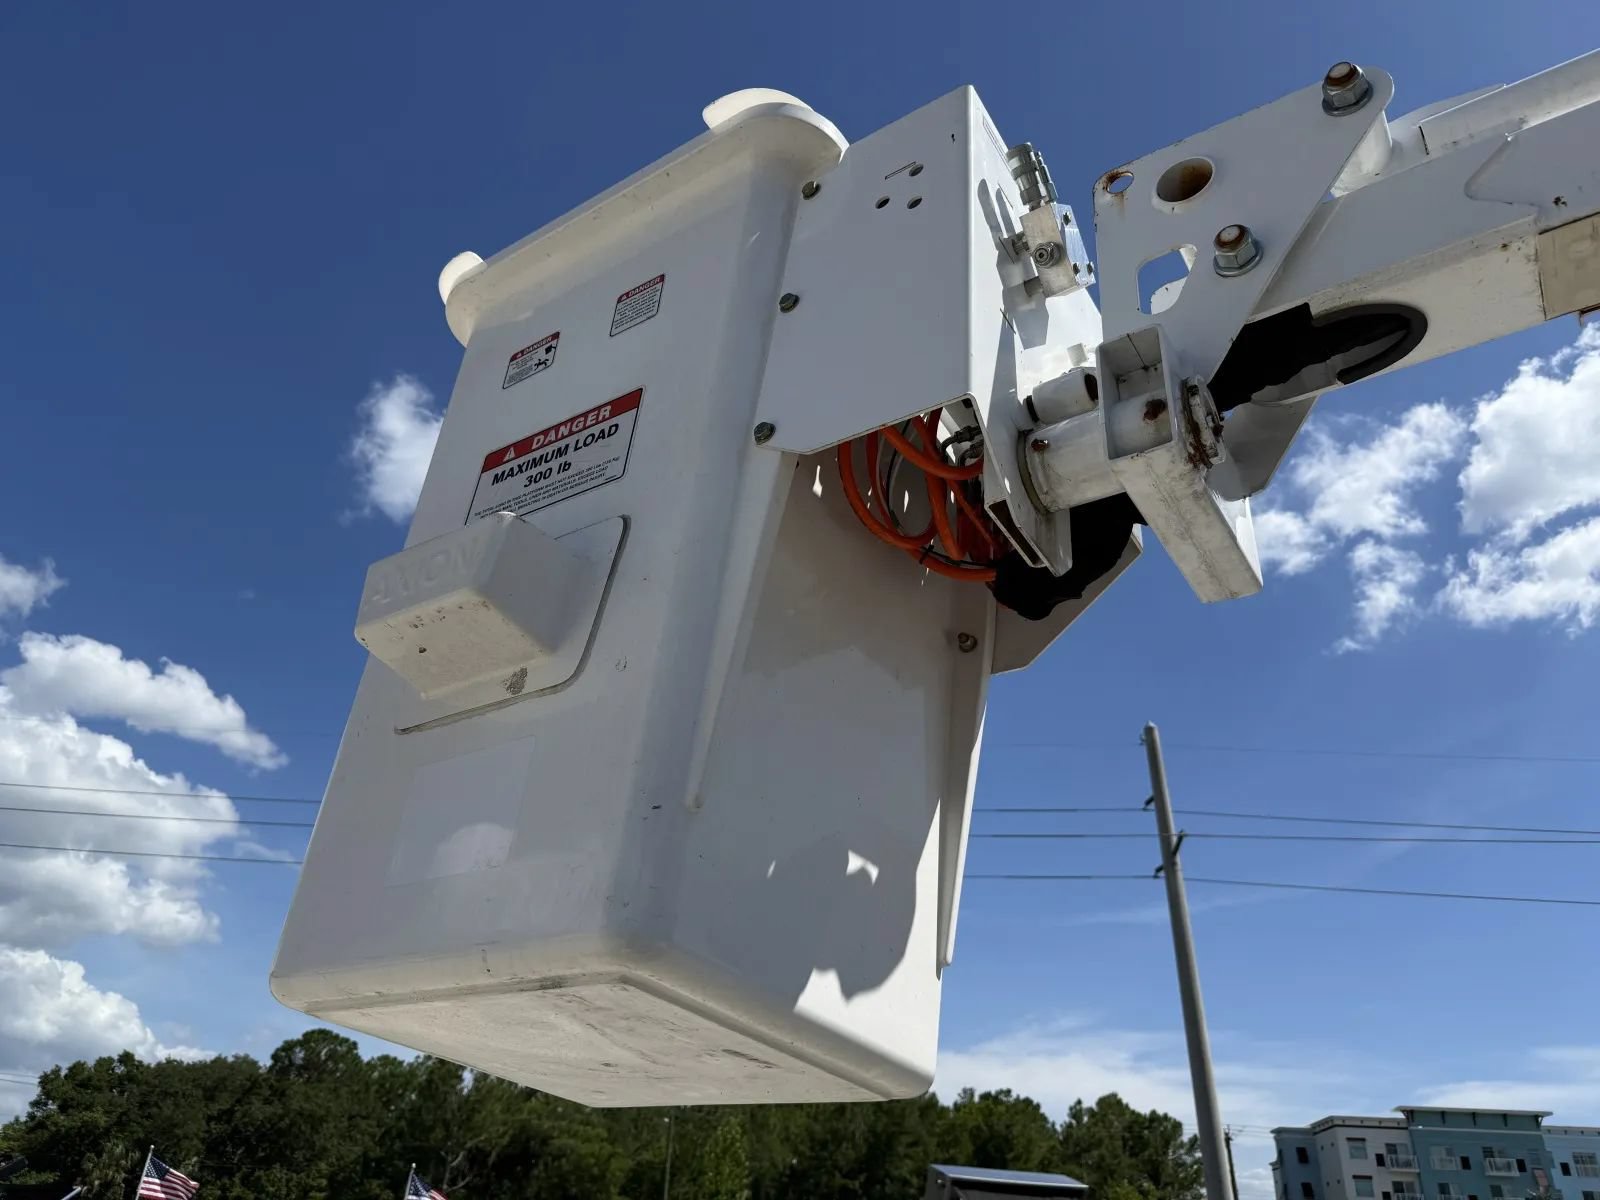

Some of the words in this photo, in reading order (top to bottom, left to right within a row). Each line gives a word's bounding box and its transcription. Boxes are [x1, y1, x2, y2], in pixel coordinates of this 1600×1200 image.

[628, 277, 662, 297] DANGER
[523, 336, 553, 356] DANGER
[531, 405, 612, 450] DANGER
[491, 444, 570, 487] MAXIMUM
[573, 422, 620, 452] LOAD
[523, 468, 553, 488] 300
[556, 460, 572, 476] lb
